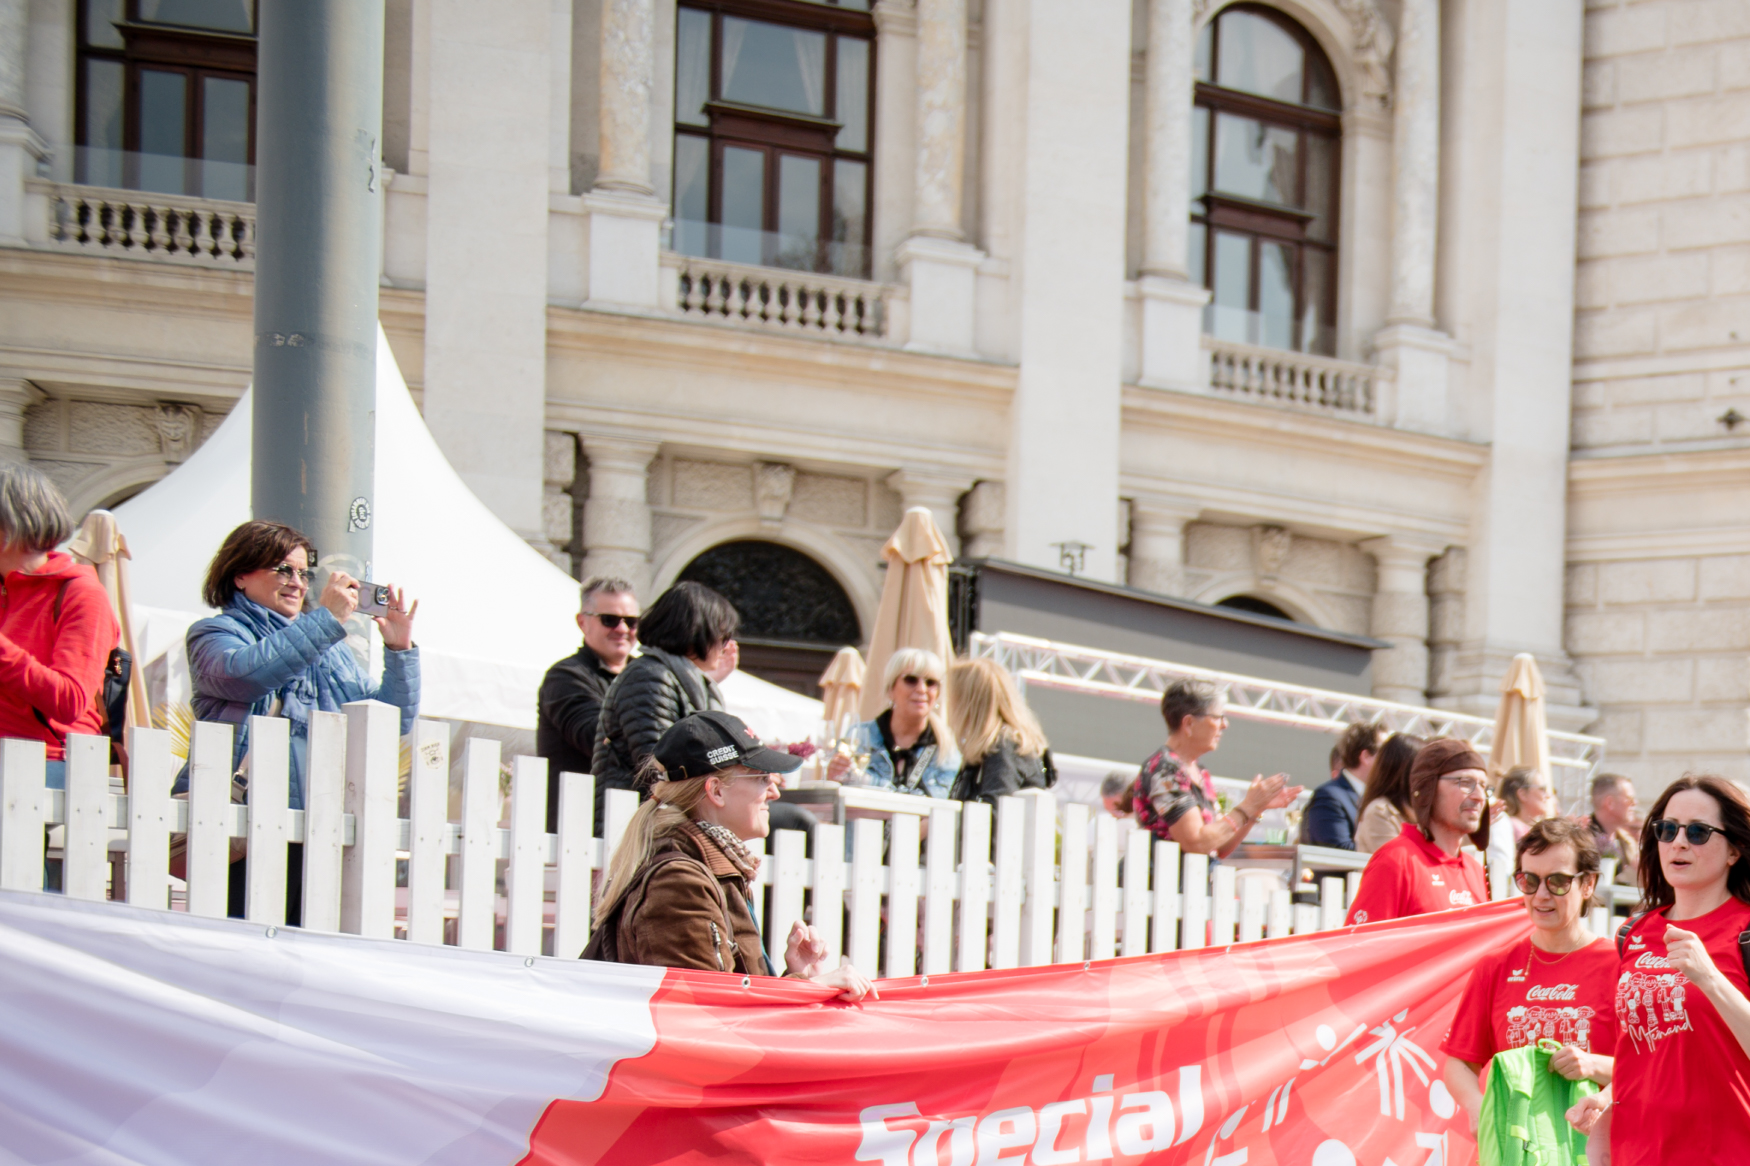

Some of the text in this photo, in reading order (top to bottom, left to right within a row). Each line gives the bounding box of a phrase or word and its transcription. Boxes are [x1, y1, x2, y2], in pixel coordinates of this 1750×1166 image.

[706, 744, 735, 759] CREDIT
[709, 751, 739, 765] SUISSE
[1526, 983, 1579, 1001] Coca-Cola
